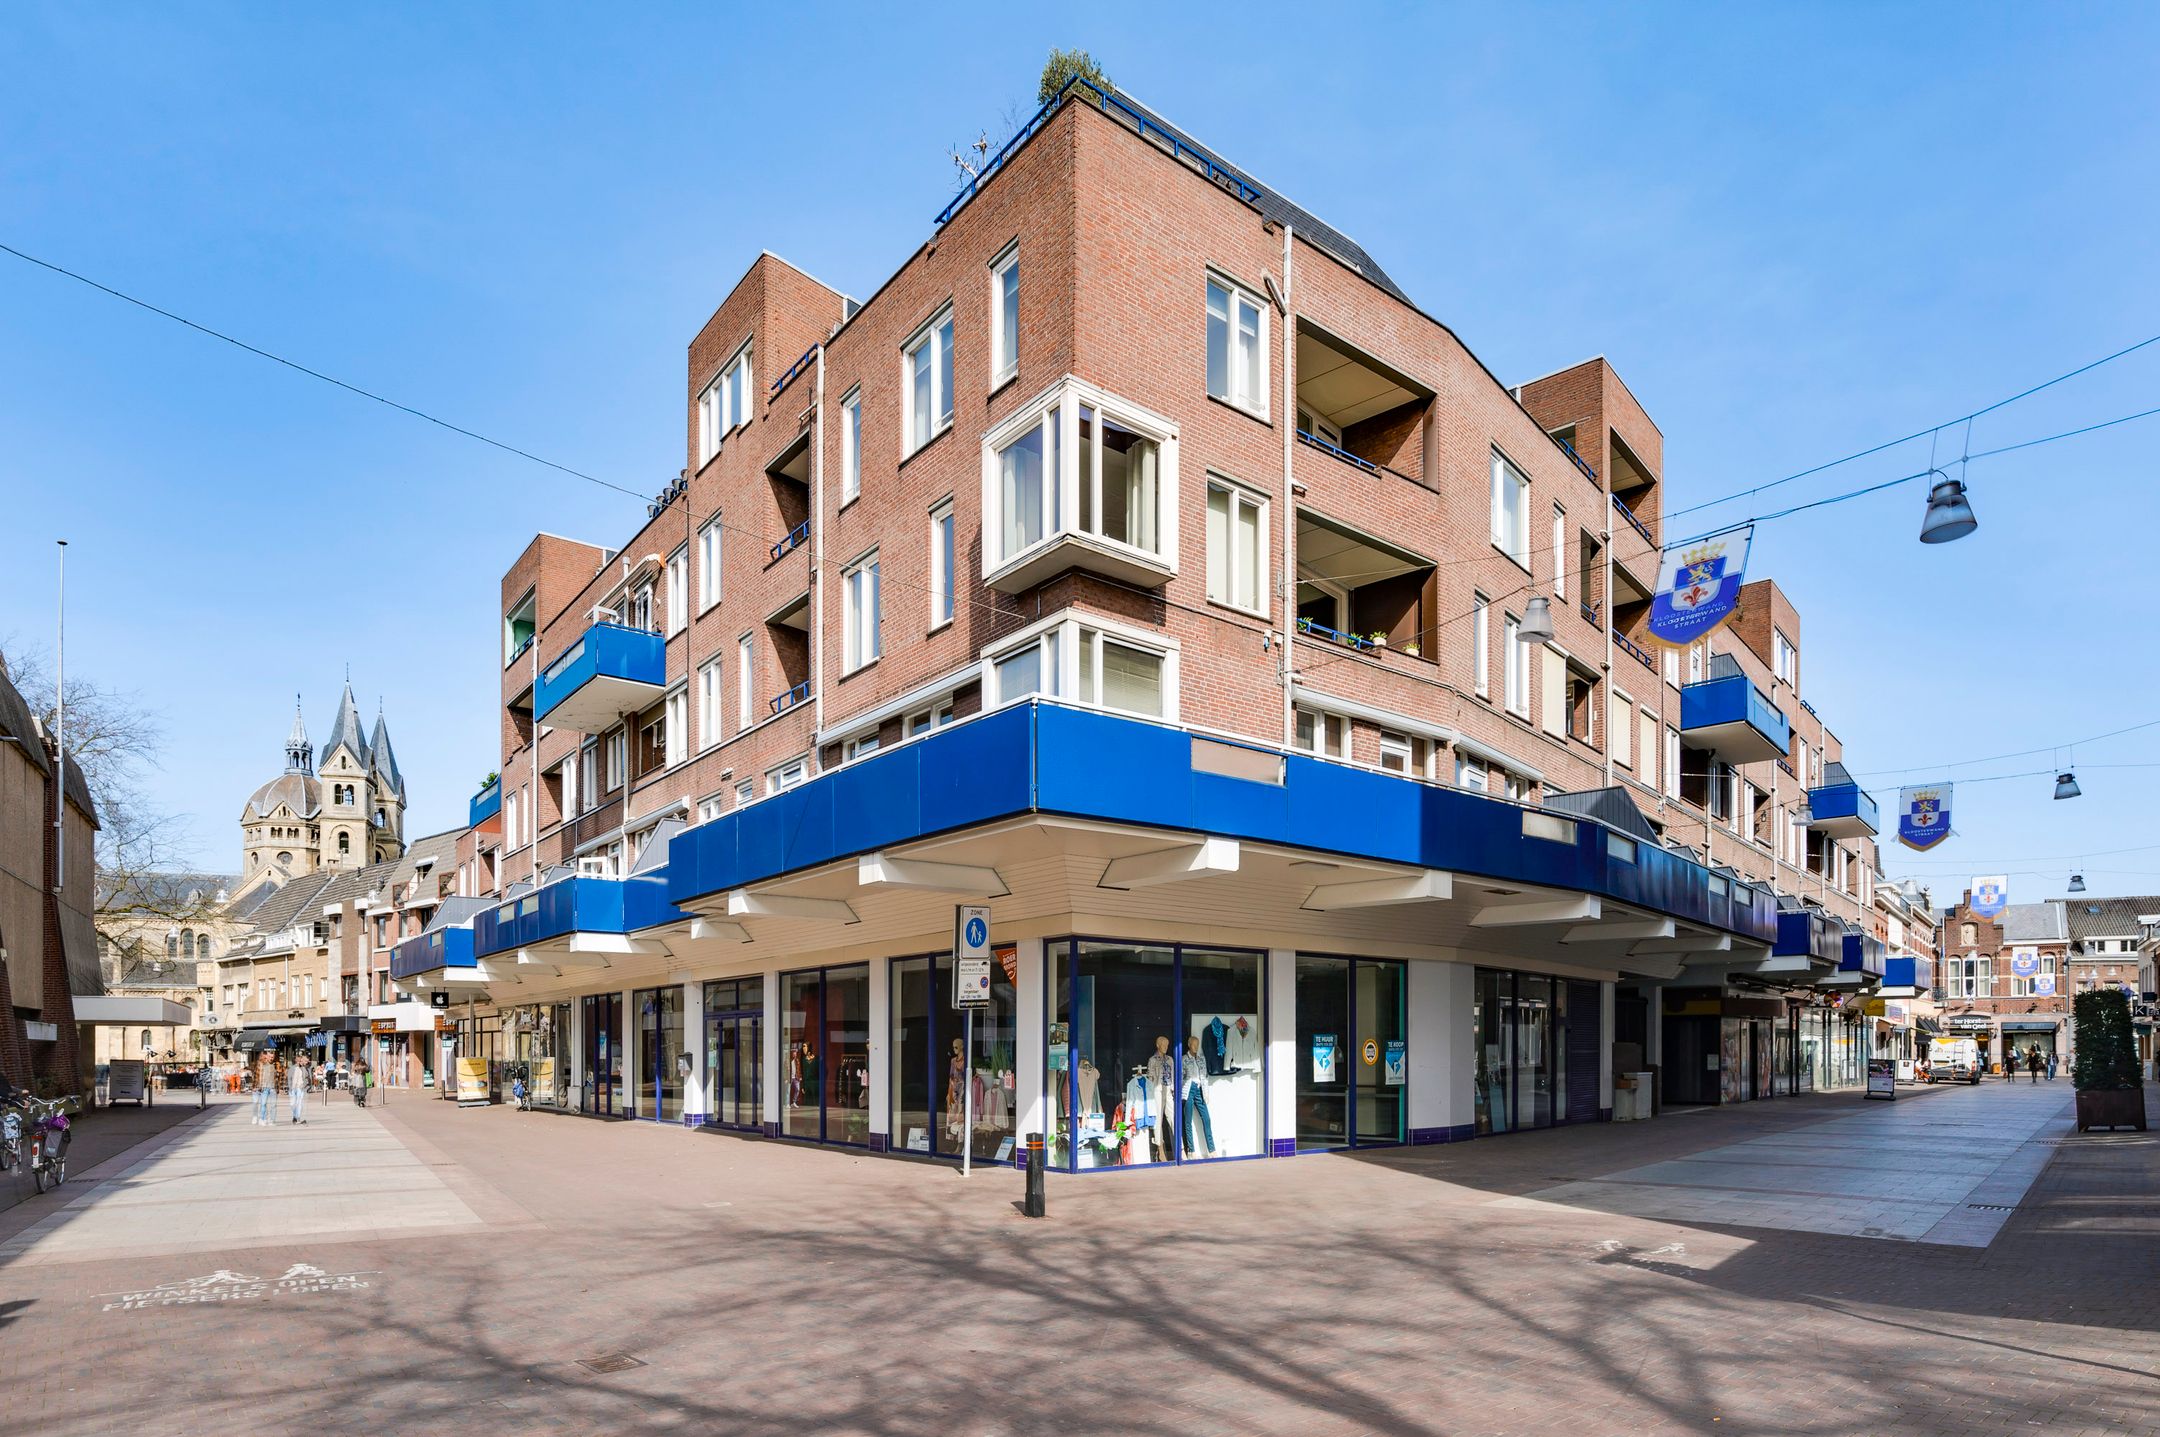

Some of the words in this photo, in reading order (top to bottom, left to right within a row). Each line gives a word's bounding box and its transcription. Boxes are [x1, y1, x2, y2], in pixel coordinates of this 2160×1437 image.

[1657, 605, 1727, 627] KLOOSTERWAND
[1674, 616, 1707, 629] STRAAT
[2135, 1006, 2144, 1015] K
[122, 1282, 268, 1302] WINKELS
[278, 1275, 357, 1288] OPEN
[102, 1291, 260, 1311] FIETSERS
